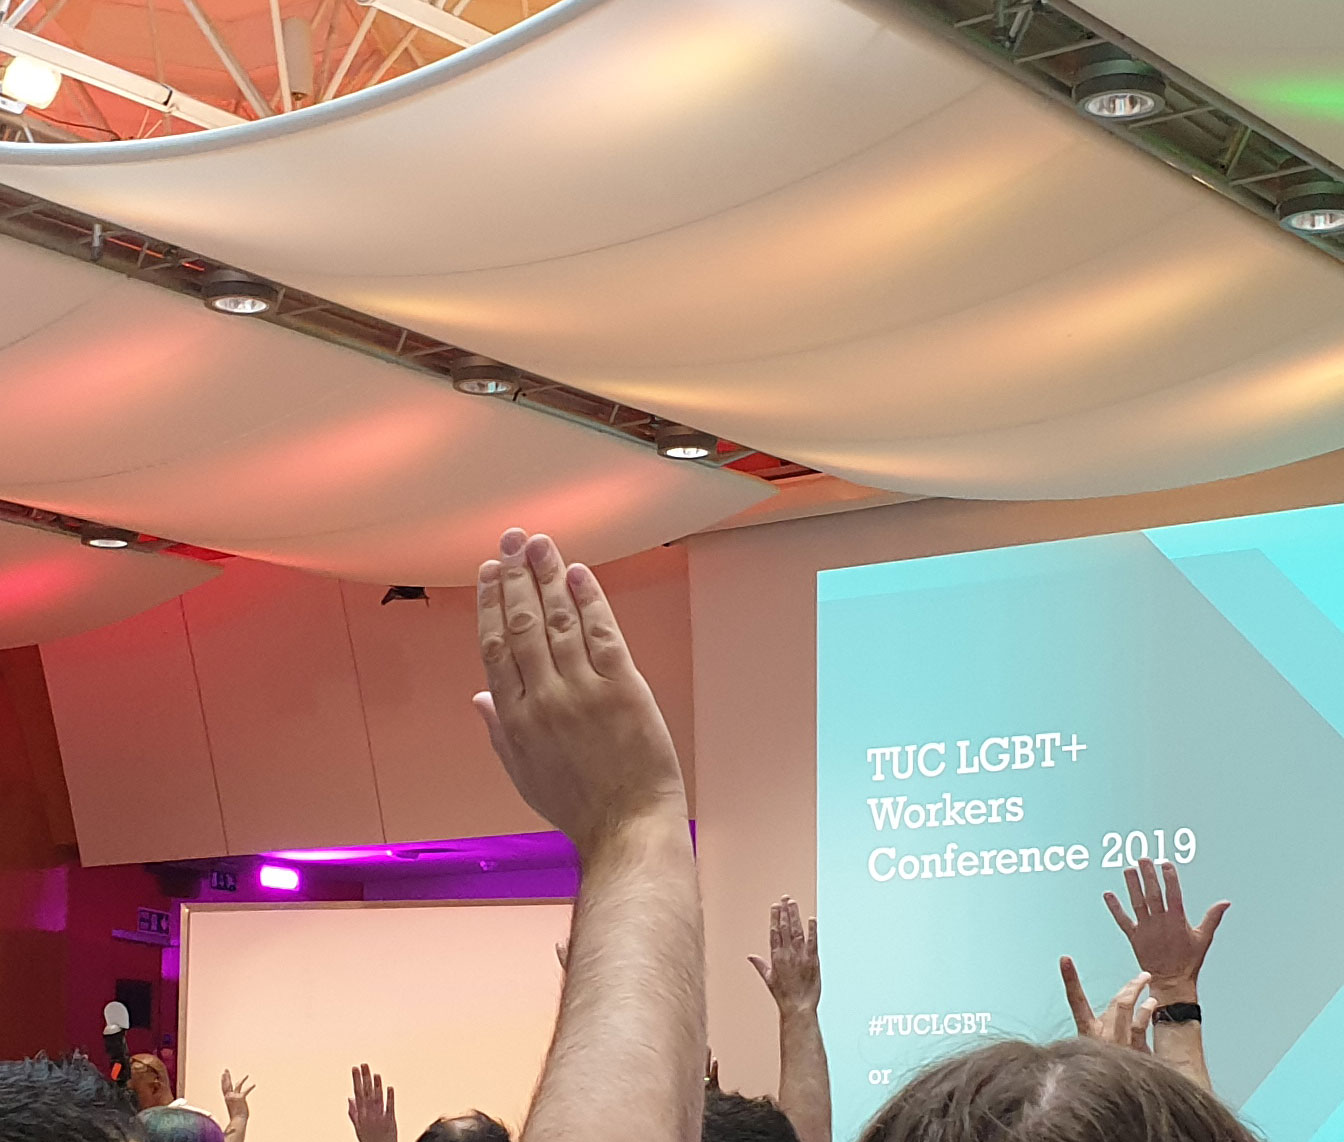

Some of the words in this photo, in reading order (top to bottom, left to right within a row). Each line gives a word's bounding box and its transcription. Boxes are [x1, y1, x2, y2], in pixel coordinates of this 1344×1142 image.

[866, 742, 946, 781] TUC
[956, 732, 1087, 774] LGBT+
[866, 792, 1025, 831] Workers
[868, 842, 1090, 882] Conference
[1101, 827, 1197, 868] 2019
[868, 1012, 992, 1036] #TUCLGBT
[868, 1069, 893, 1085] or
